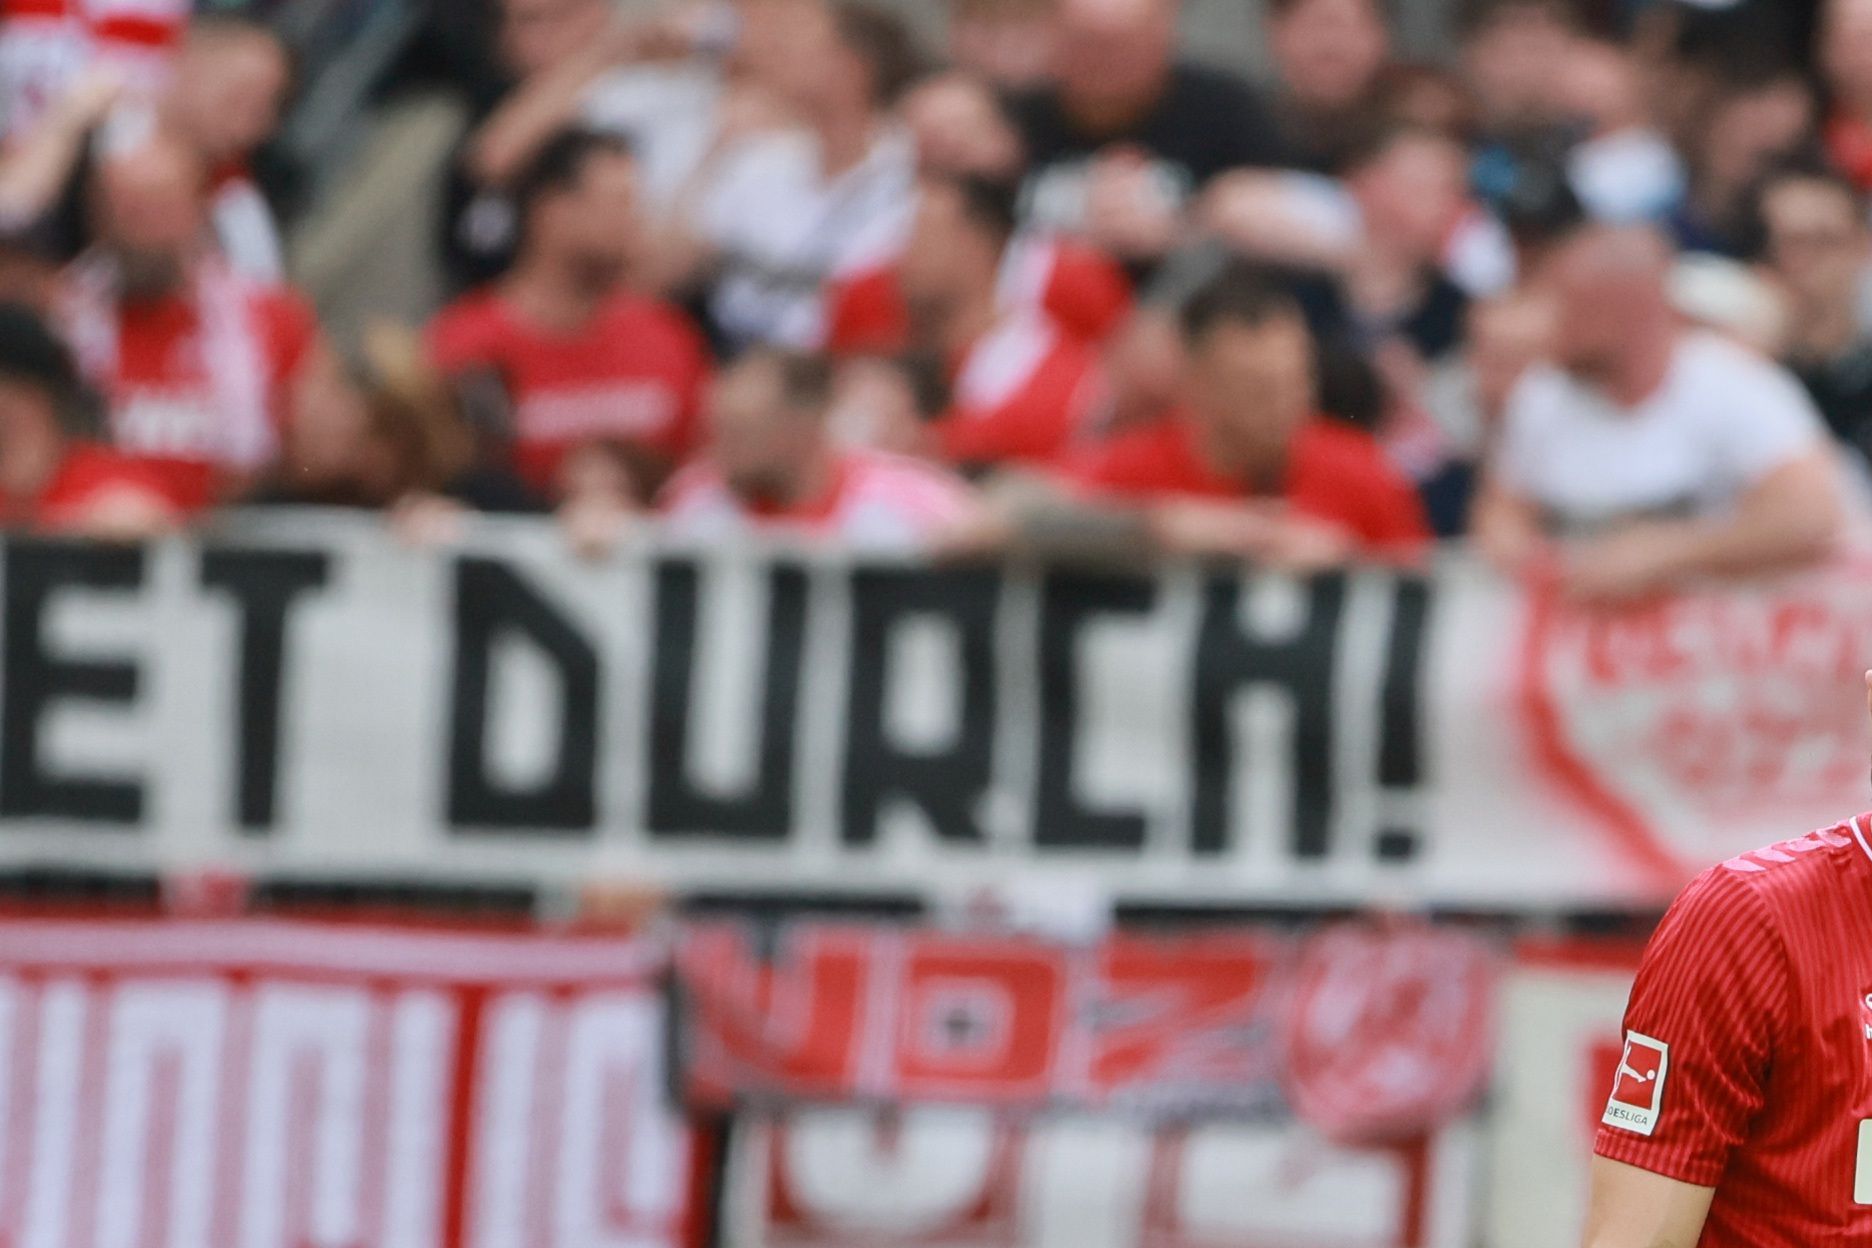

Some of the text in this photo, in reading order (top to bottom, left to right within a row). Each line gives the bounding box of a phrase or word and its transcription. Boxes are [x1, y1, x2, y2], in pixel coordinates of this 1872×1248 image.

[2, 542, 328, 828] ET
[448, 555, 1428, 860] DURCH!
[1607, 1105, 1648, 1126] DESLIGA
